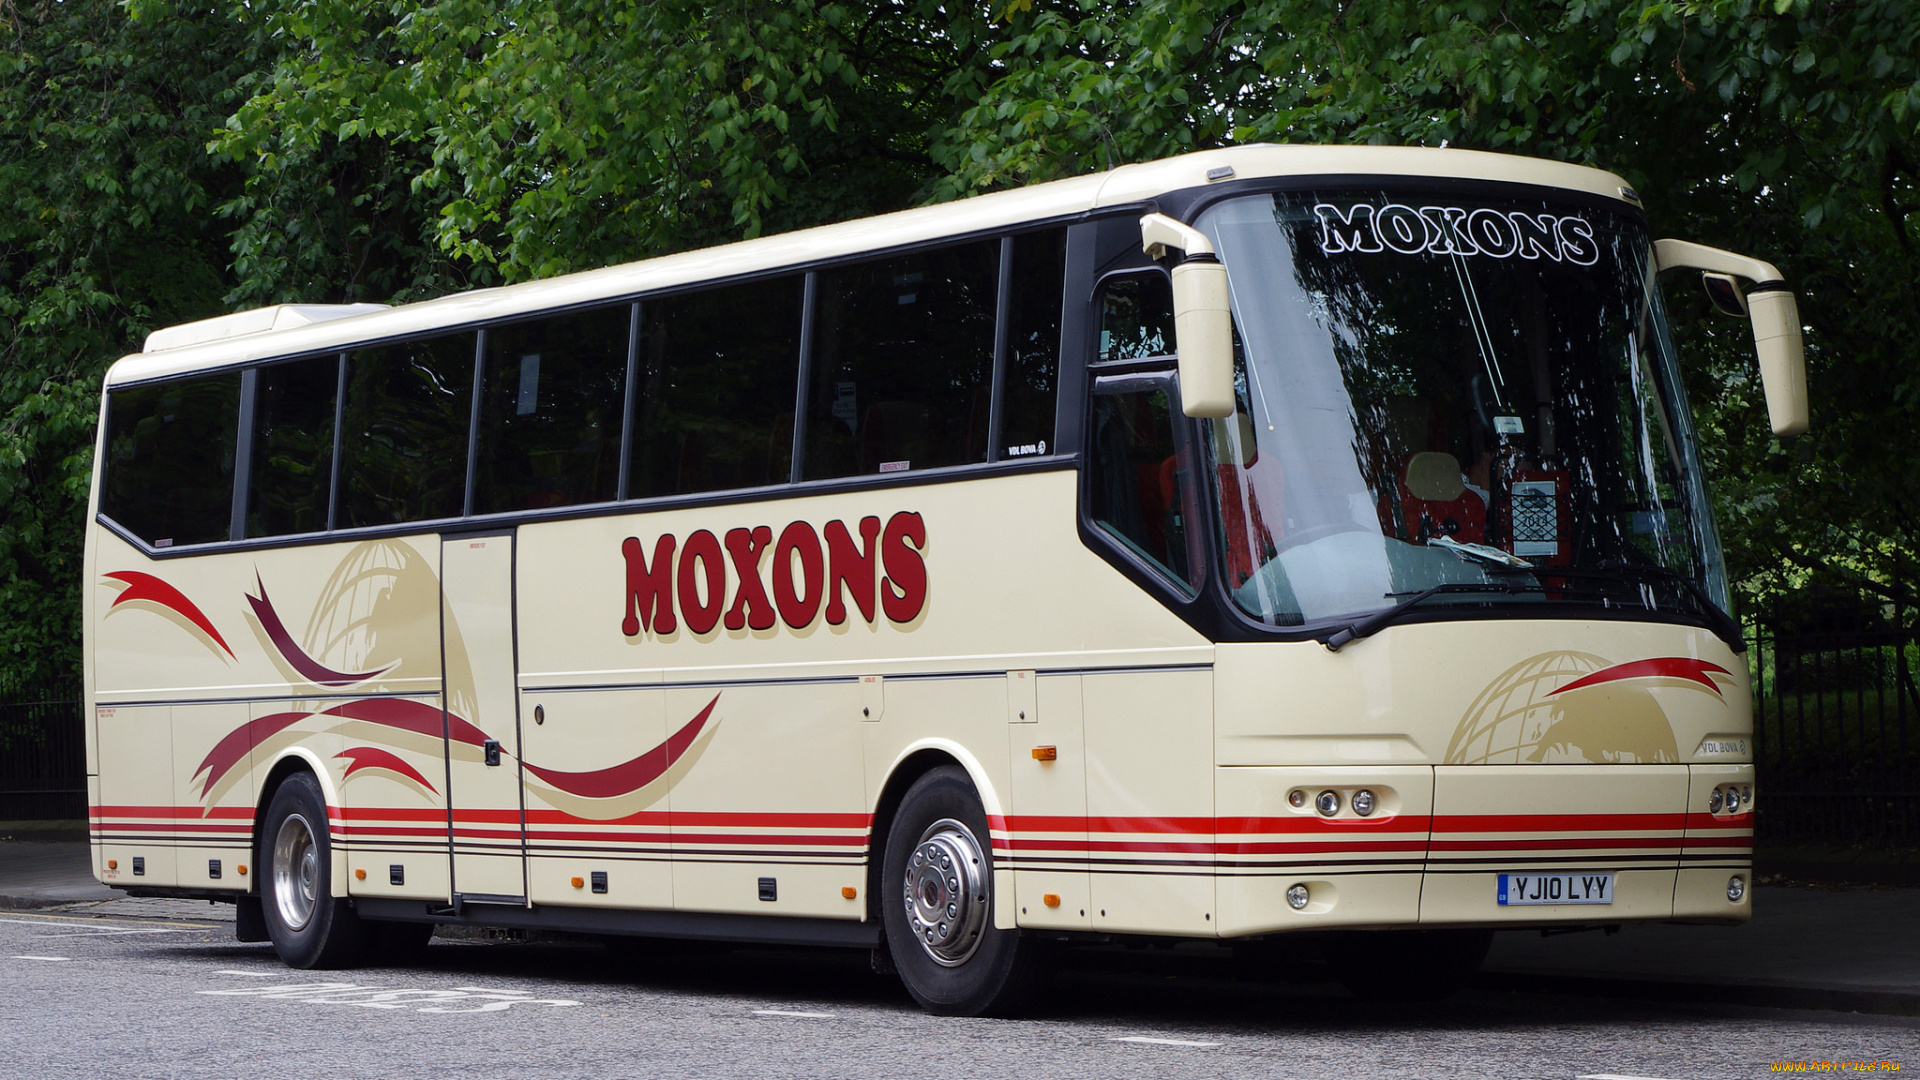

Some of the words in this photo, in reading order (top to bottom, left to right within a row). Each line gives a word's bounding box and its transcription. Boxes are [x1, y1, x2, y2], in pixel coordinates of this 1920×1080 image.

[1313, 204, 1599, 266] MOXONS
[1008, 446, 1020, 456] VDL
[1020, 444, 1037, 455] BOVA
[621, 511, 928, 637] MOXONS
[1701, 742, 1719, 753] VDL
[1719, 742, 1739, 753] BOVA
[1516, 877, 1562, 900] YJ10
[1568, 876, 1608, 900] LYY
